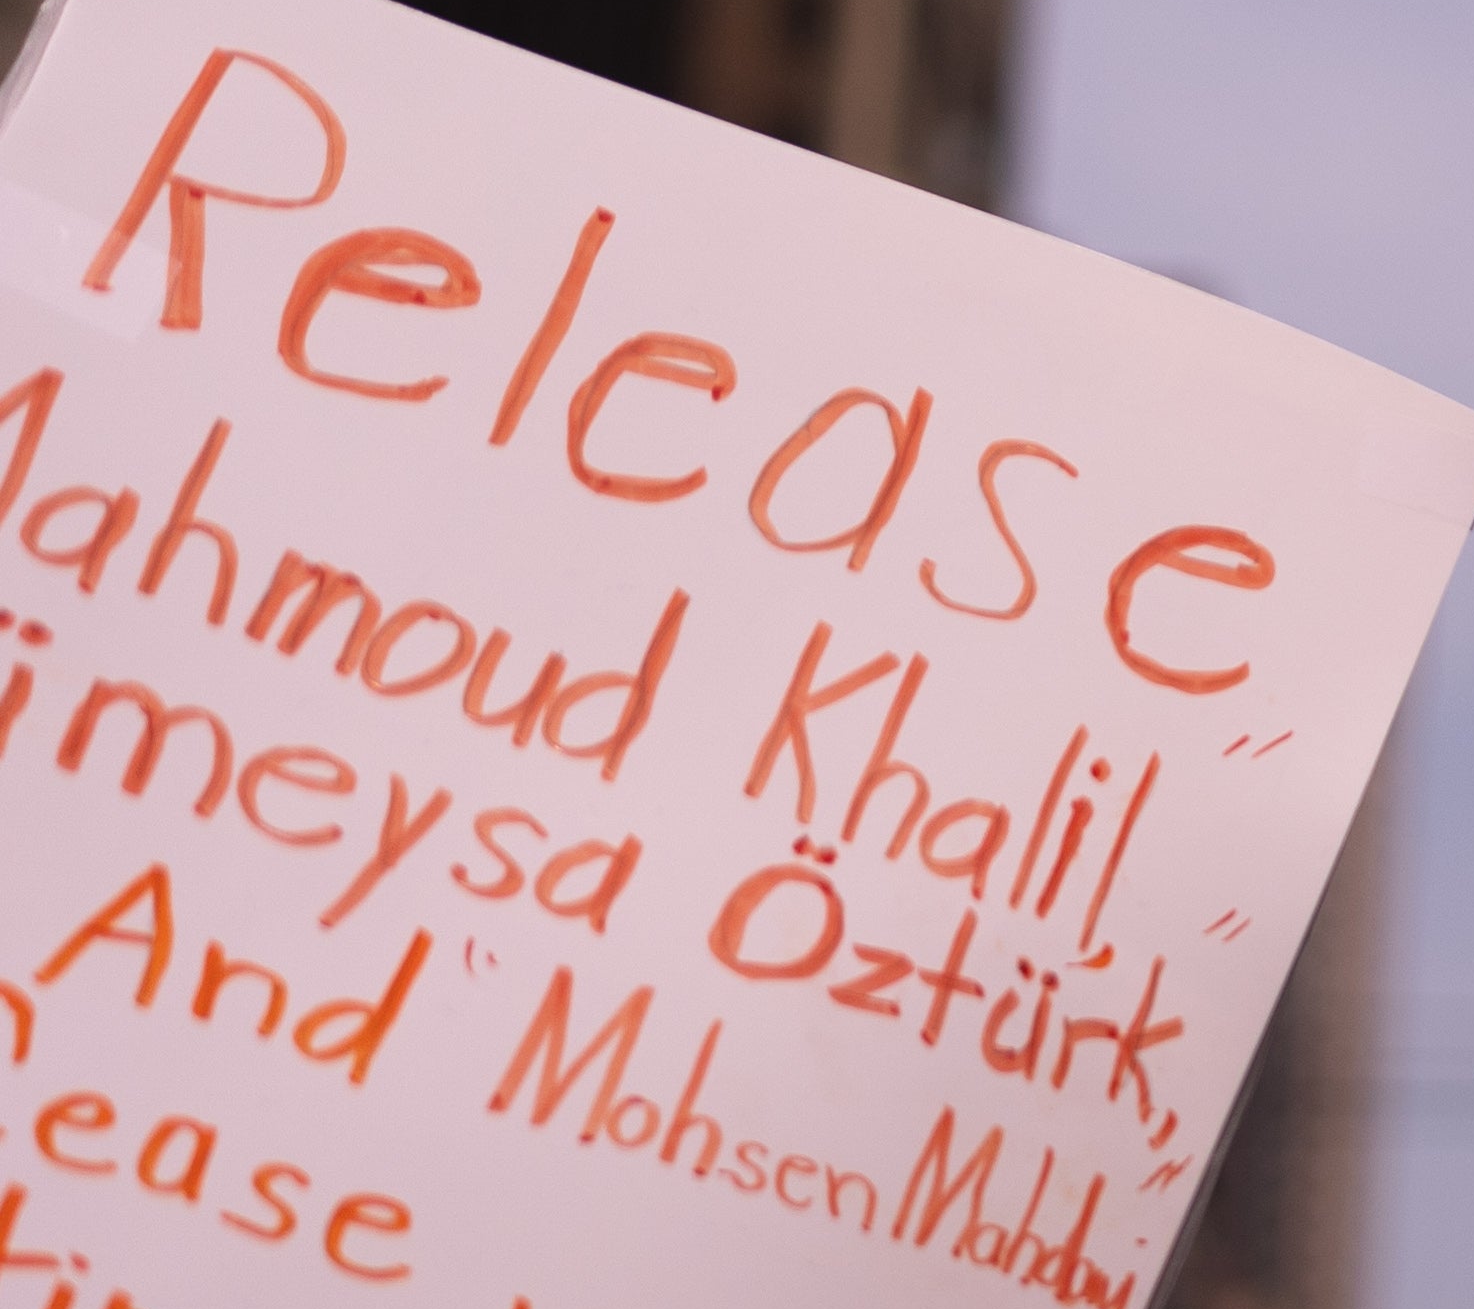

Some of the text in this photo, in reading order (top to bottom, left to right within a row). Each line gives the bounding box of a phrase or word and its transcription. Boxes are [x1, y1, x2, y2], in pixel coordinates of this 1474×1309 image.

[82, 46, 1276, 694] Release
[33, 861, 433, 1088] And
[0, 980, 412, 1283] ease
